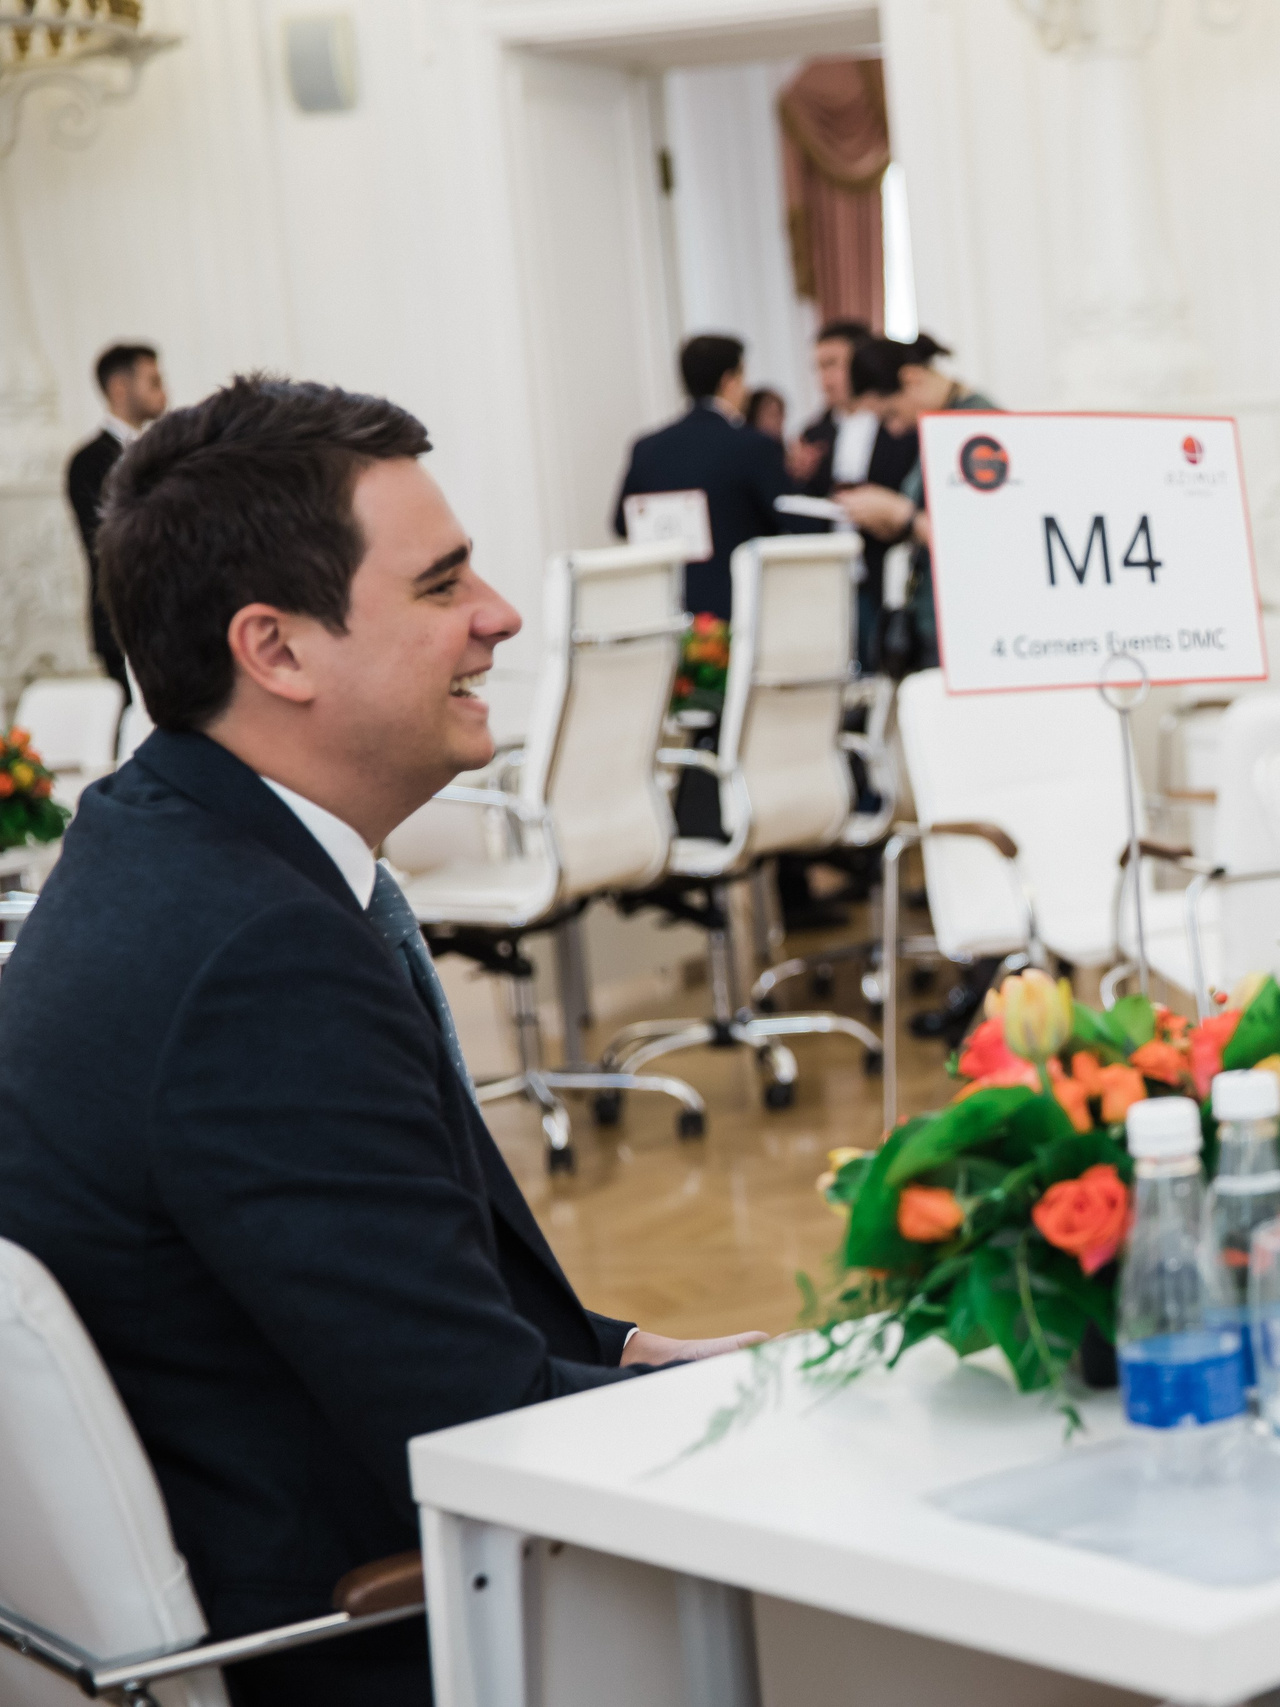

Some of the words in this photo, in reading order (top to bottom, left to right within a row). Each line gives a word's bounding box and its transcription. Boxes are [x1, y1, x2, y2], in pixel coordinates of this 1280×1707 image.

[1043, 514, 1163, 586] M4
[992, 637, 1006, 658] 4
[1013, 635, 1099, 660] Corners
[1106, 630, 1172, 656] Events
[1179, 627, 1226, 652] DMC
